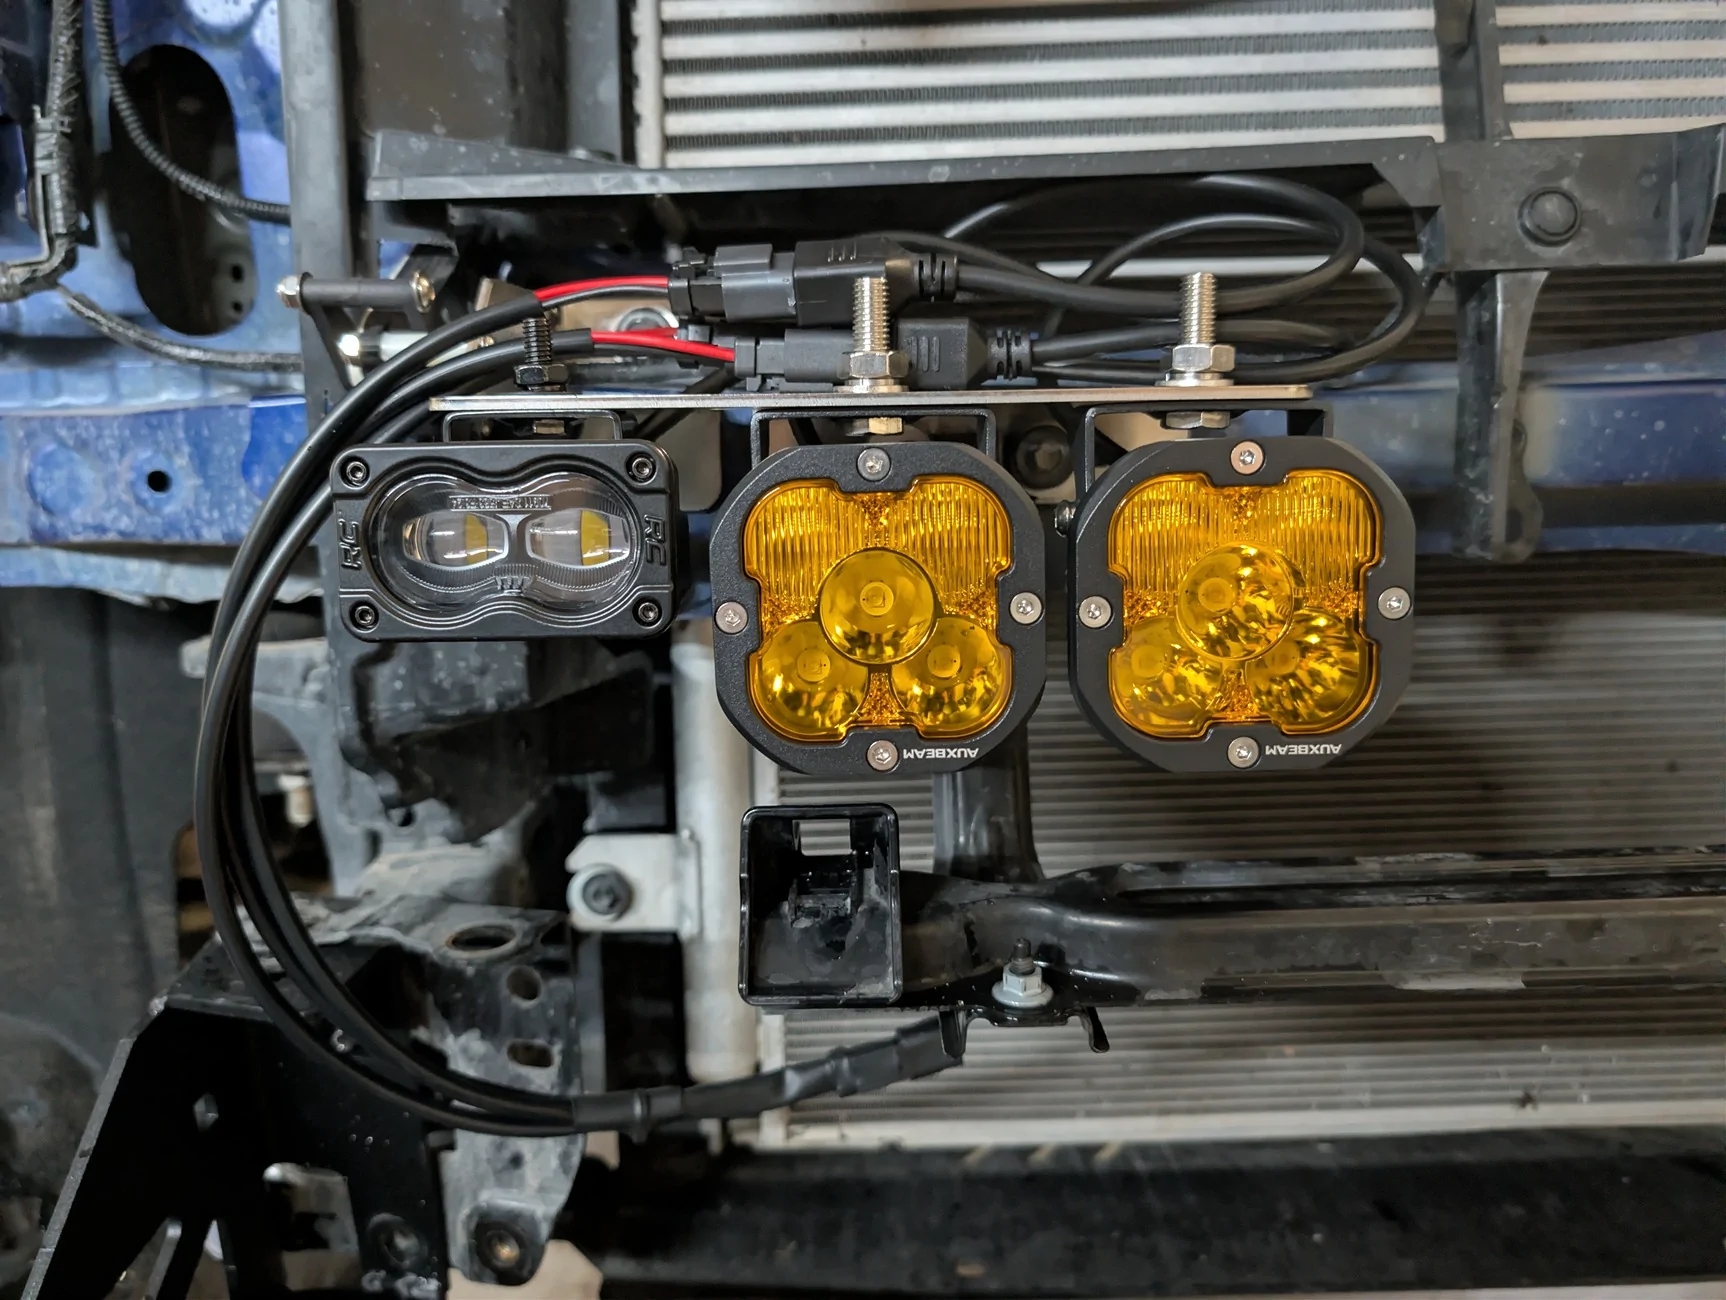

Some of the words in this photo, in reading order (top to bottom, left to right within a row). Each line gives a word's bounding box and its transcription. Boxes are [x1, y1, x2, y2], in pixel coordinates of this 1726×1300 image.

[338, 518, 362, 570] RC
[643, 514, 666, 566] RC
[903, 748, 979, 759] AUXBEAM
[1265, 743, 1342, 755] AUXBEAM
